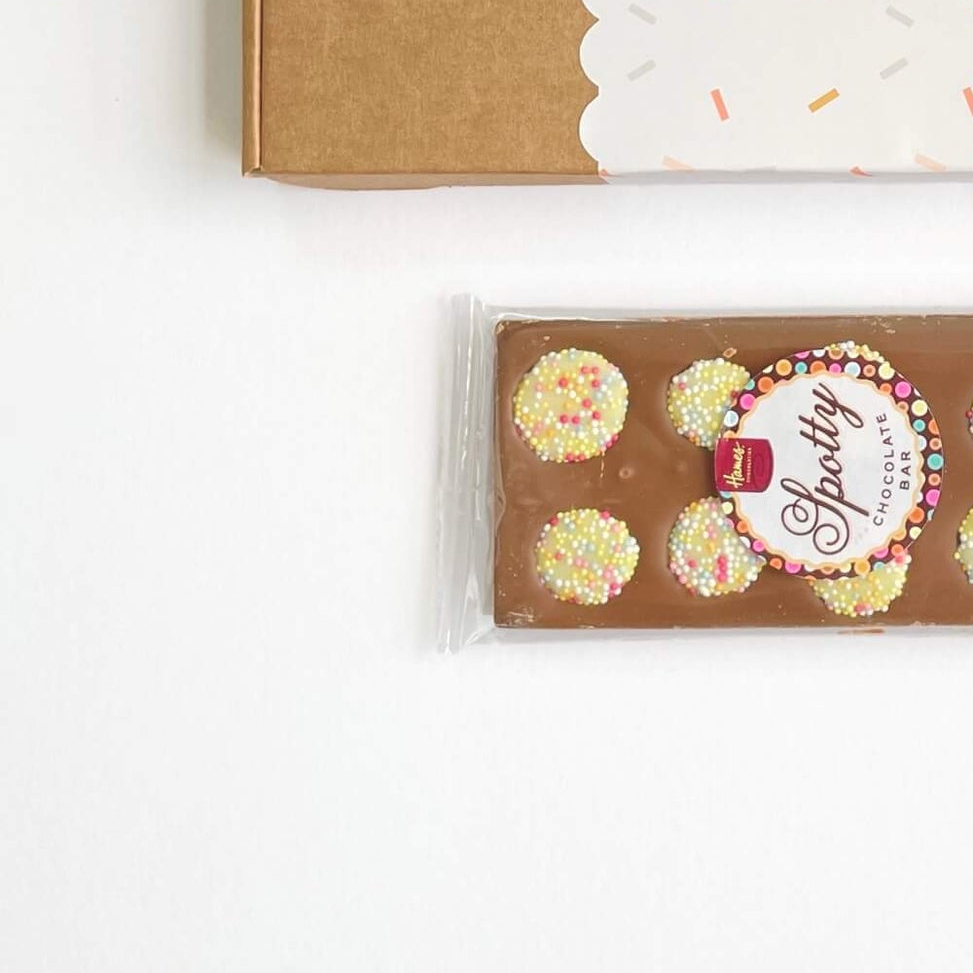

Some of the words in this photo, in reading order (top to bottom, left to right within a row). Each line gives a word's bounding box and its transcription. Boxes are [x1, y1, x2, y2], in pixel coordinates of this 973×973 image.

[780, 382, 870, 555] Spotty
[873, 413, 895, 527] CHOCOLATE
[899, 450, 911, 491] BAR
